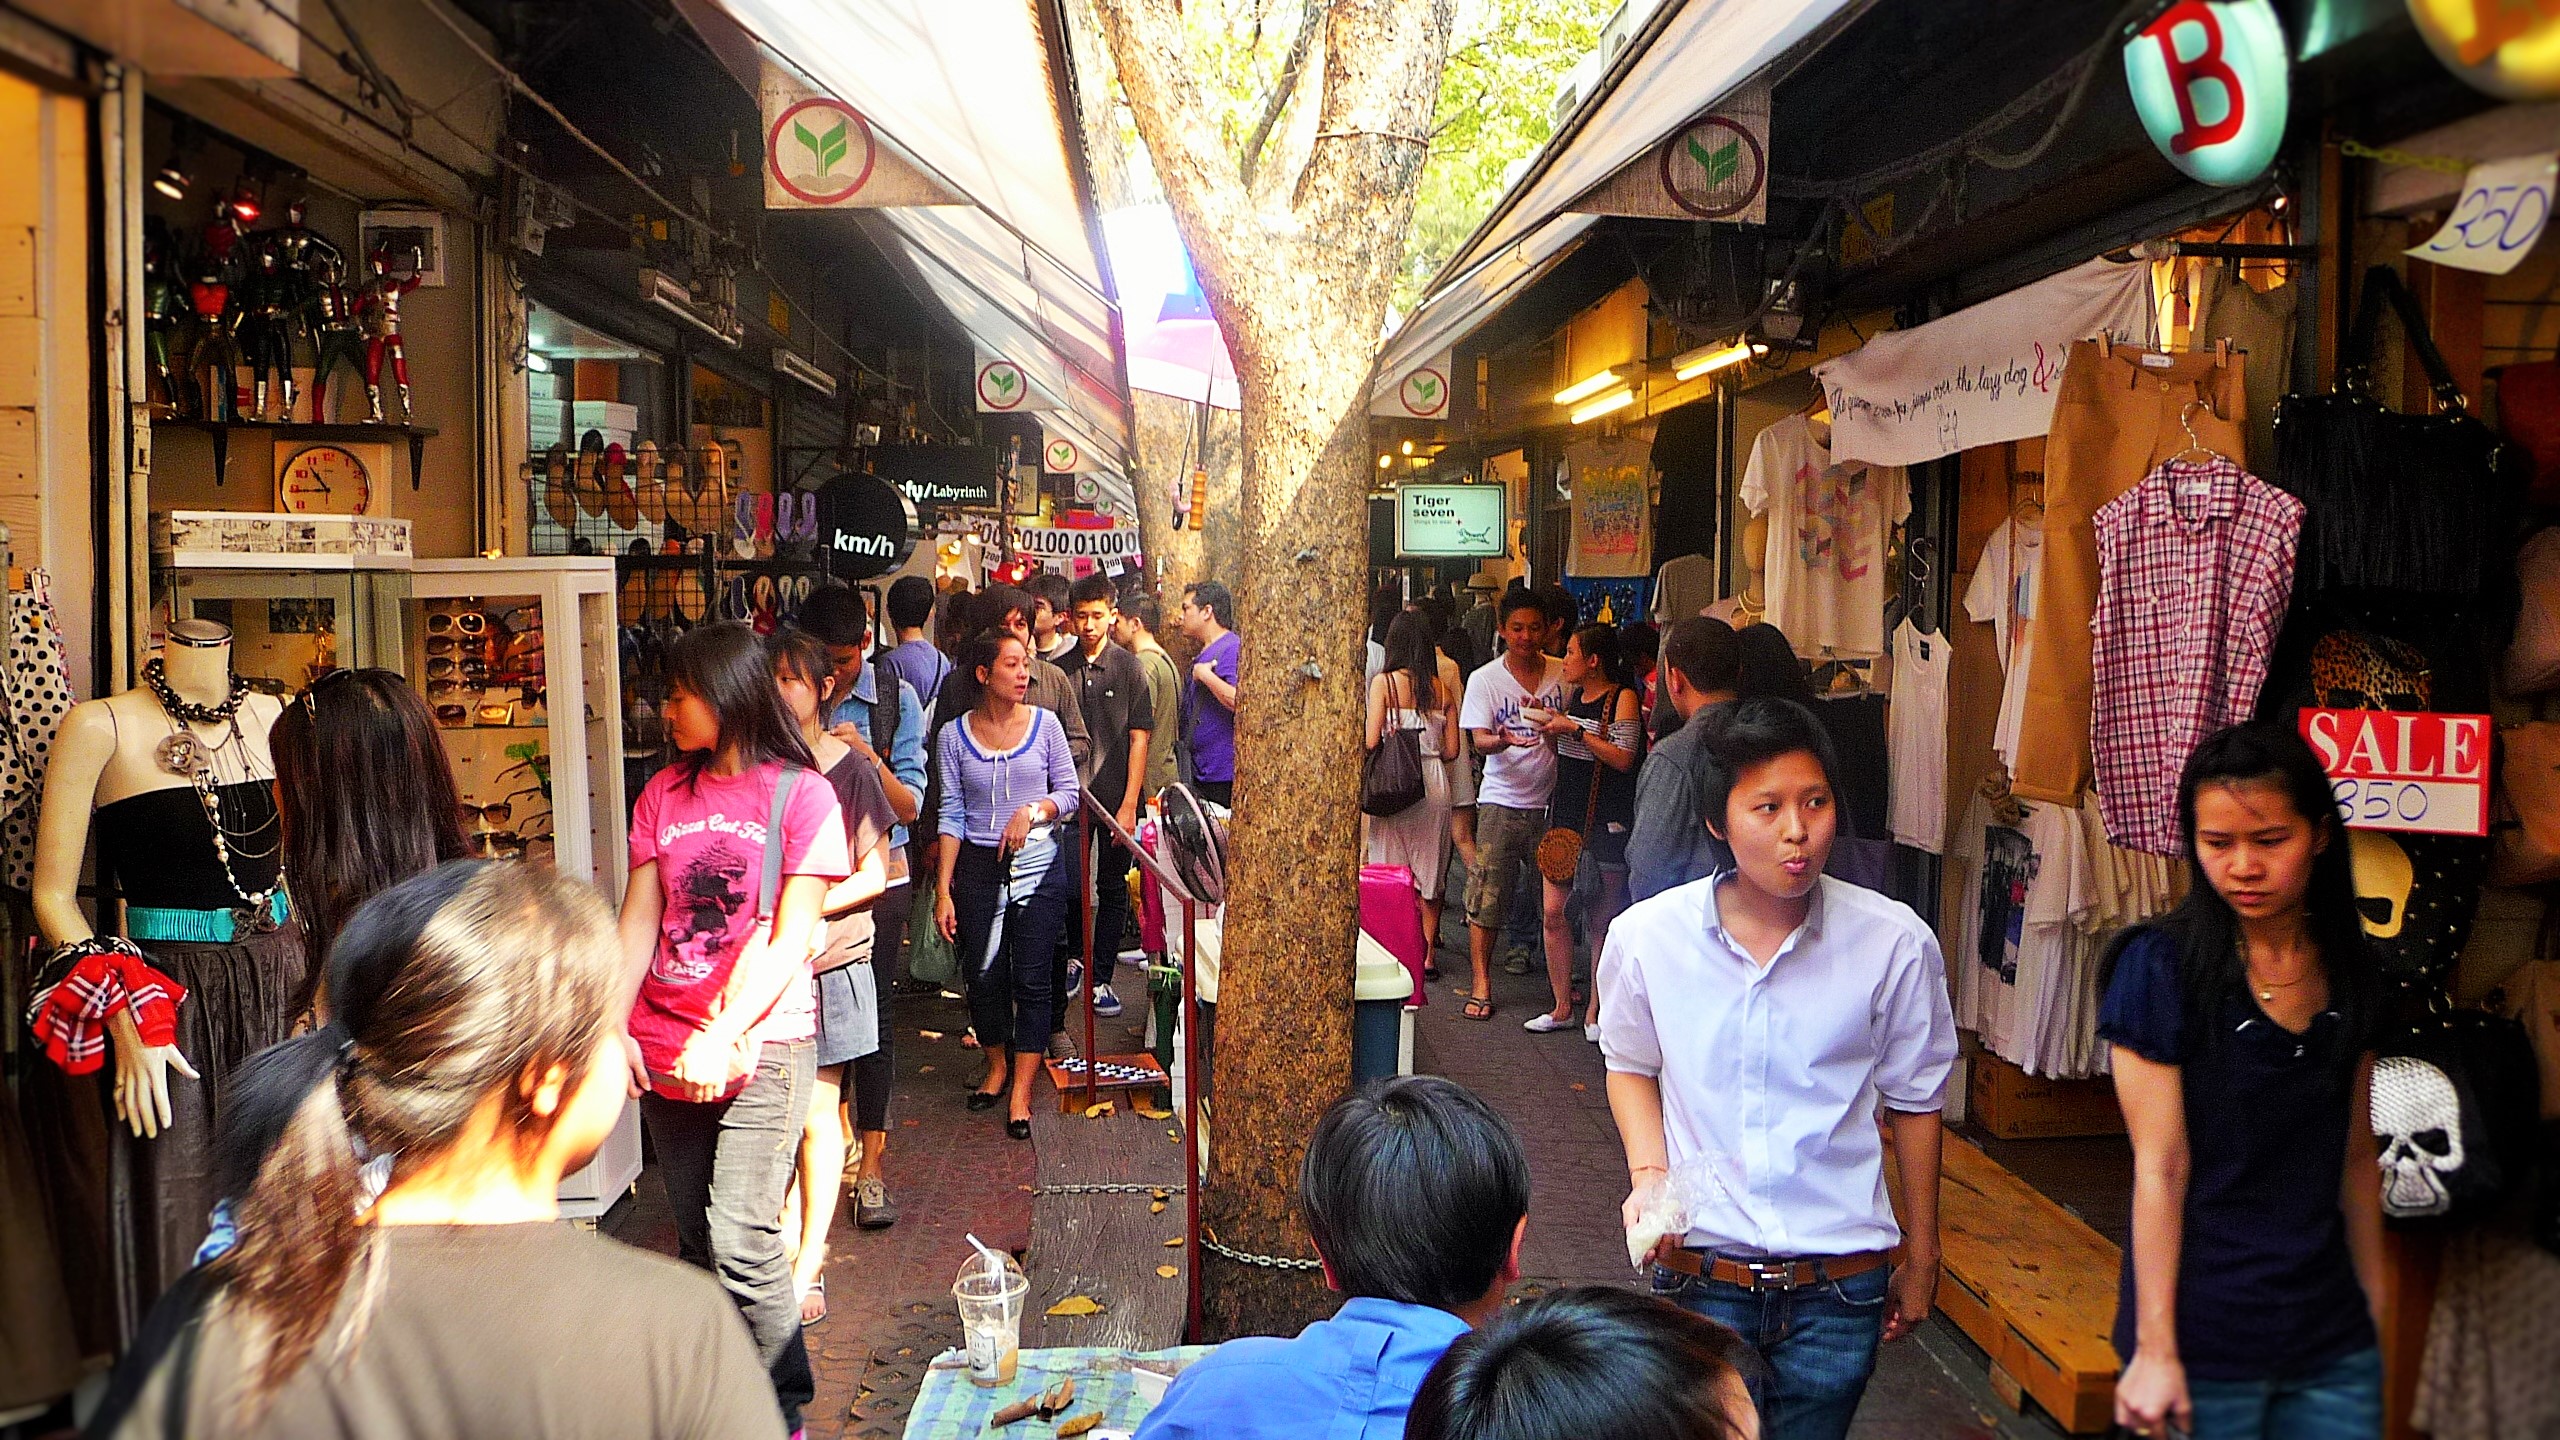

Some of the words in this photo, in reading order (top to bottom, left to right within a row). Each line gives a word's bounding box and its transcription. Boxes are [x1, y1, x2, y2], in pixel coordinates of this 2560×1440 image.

[2139, 0, 2245, 155] B
[2430, 185, 2548, 251] 350
[1956, 365, 1972, 392] the
[1974, 365, 2002, 400] lazy
[2004, 357, 2028, 396] dog
[1413, 495, 1451, 507] Tiger
[1413, 509, 1455, 517] seven
[834, 529, 895, 558] km/h
[985, 551, 1000, 562] 200
[1104, 558, 1120, 568] 200
[2309, 711, 2481, 779] SALE
